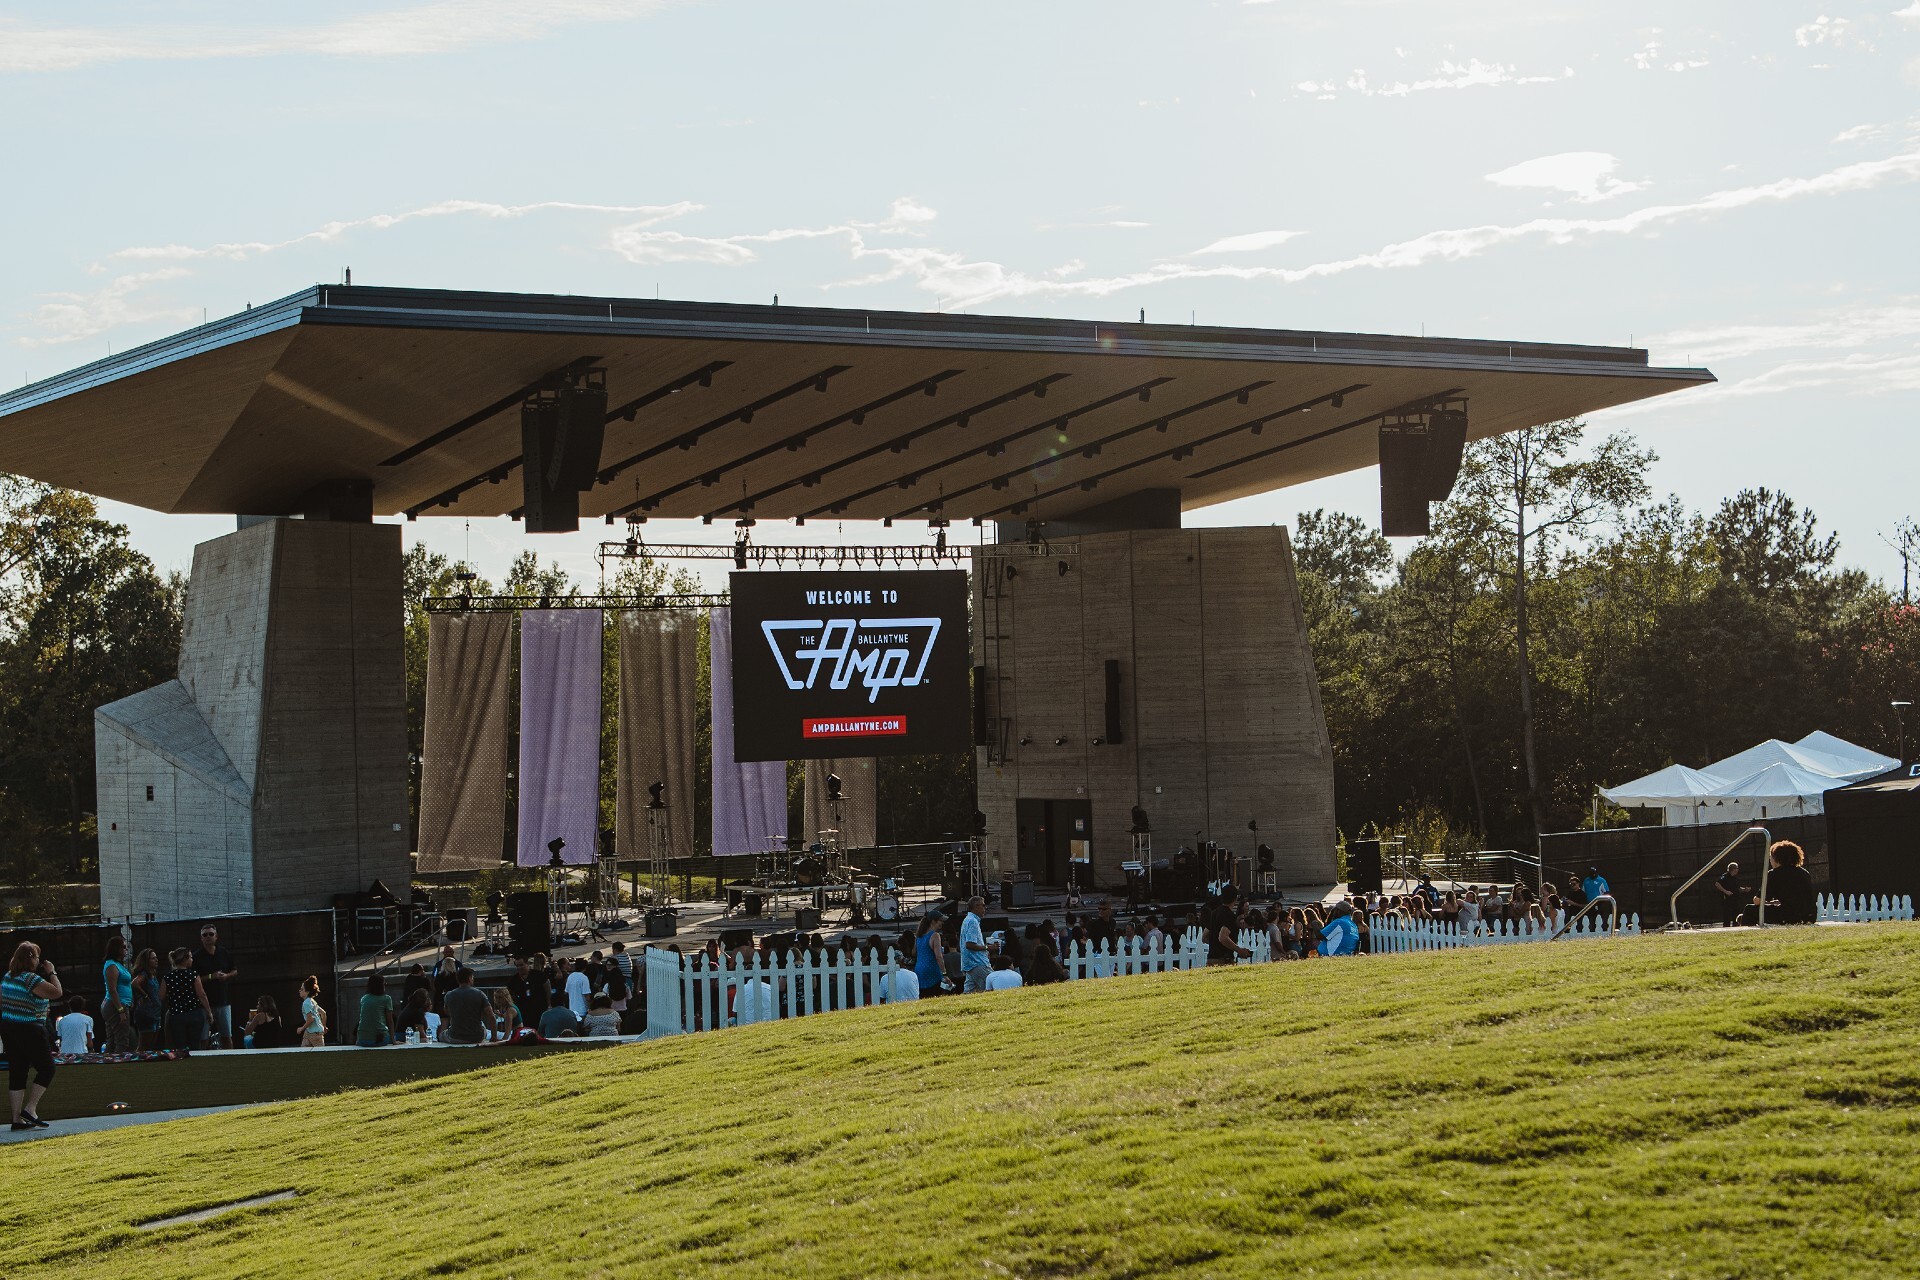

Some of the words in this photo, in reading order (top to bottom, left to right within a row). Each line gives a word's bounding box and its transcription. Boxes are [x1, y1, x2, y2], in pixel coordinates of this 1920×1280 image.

[806, 590, 871, 605] WELCOME
[882, 590, 898, 604] TO
[800, 635, 815, 645] THE
[858, 634, 909, 645] BALLANTYNE
[812, 720, 899, 733] AMPBALLANTYNE.COM
